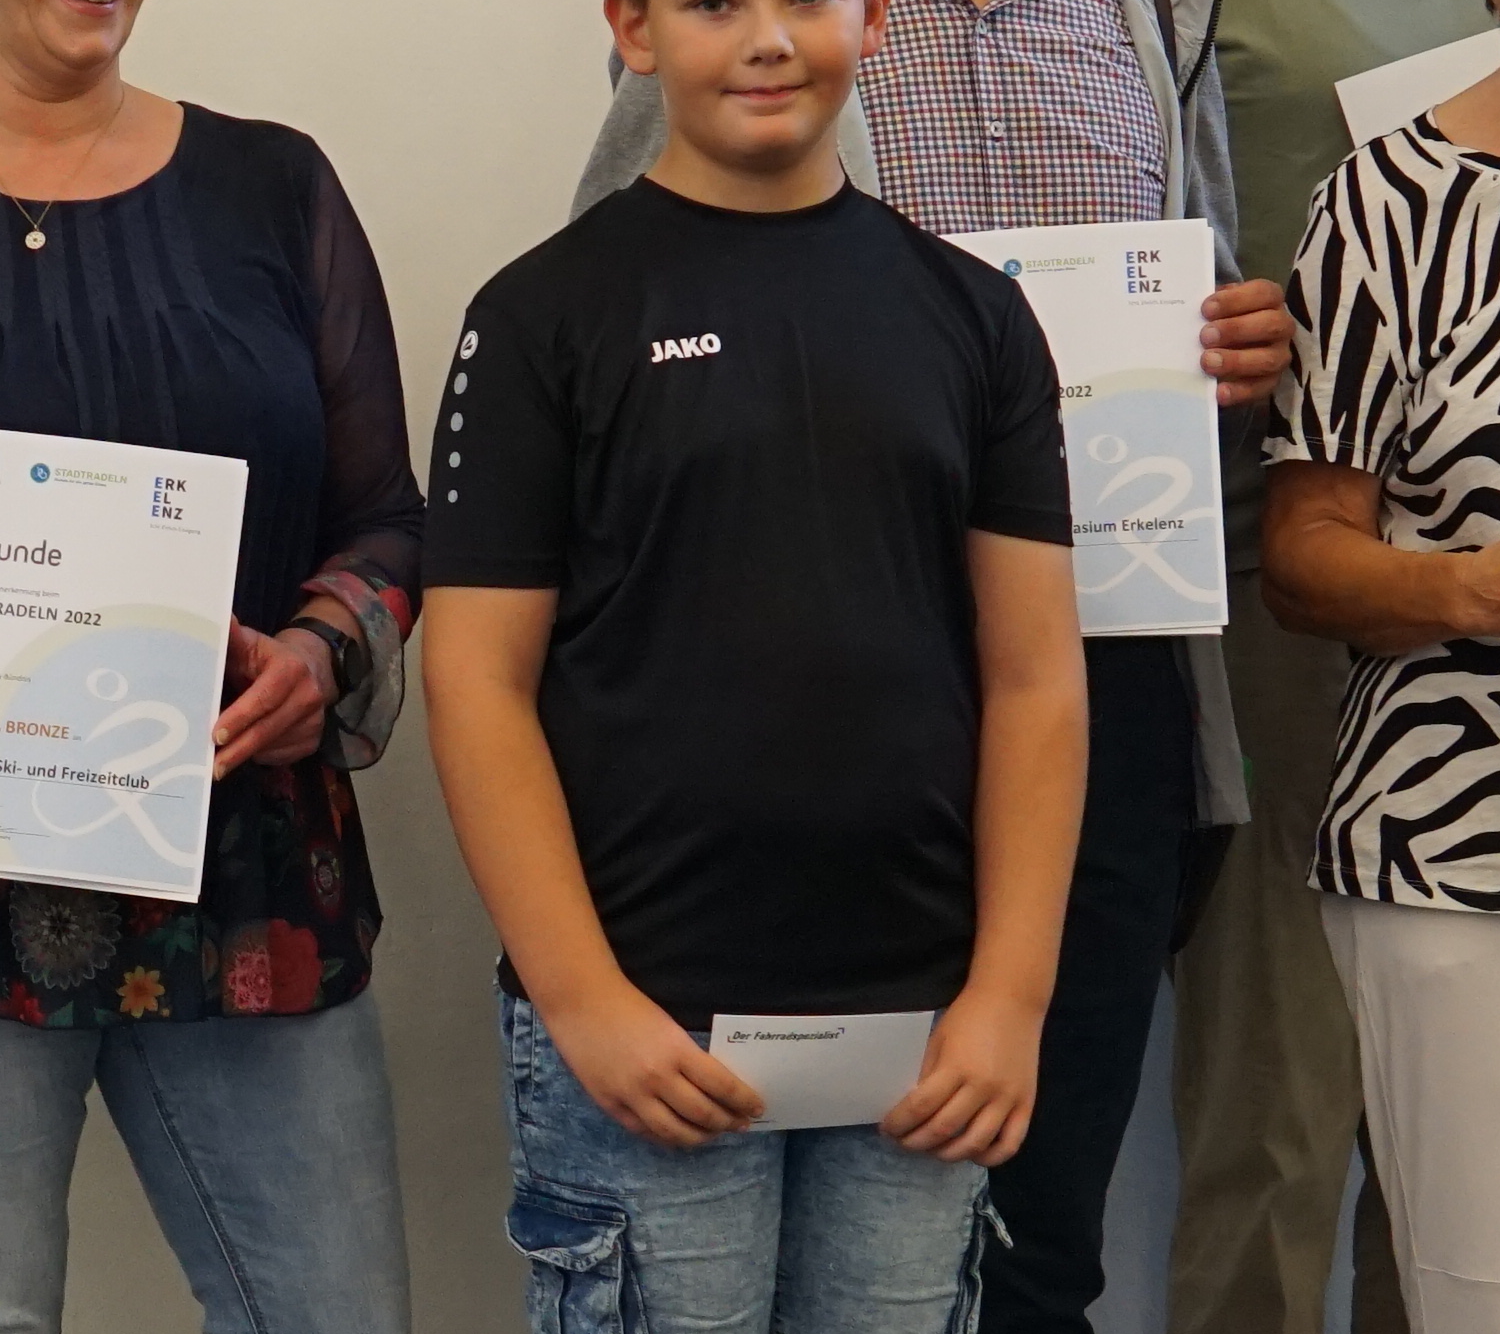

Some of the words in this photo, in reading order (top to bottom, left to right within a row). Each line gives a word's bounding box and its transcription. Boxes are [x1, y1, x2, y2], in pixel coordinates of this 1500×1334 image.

[1025, 256, 1096, 269] STADTRADELN
[1125, 250, 1162, 265] ERK
[1126, 266, 1148, 279] EL
[1127, 280, 1163, 294] ENZ
[650, 332, 722, 364] JAKO
[1058, 385, 1093, 399] 2022
[53, 467, 128, 485] STADTRADELN
[154, 476, 188, 493] ERK
[152, 490, 172, 505] EL
[151, 504, 184, 521] ENZ
[1122, 518, 1185, 532] Erkelenz
[63, 609, 102, 627] 2022
[5, 719, 70, 740] BRONZE
[26, 765, 57, 780] und
[61, 766, 151, 791] Freizeitclub
